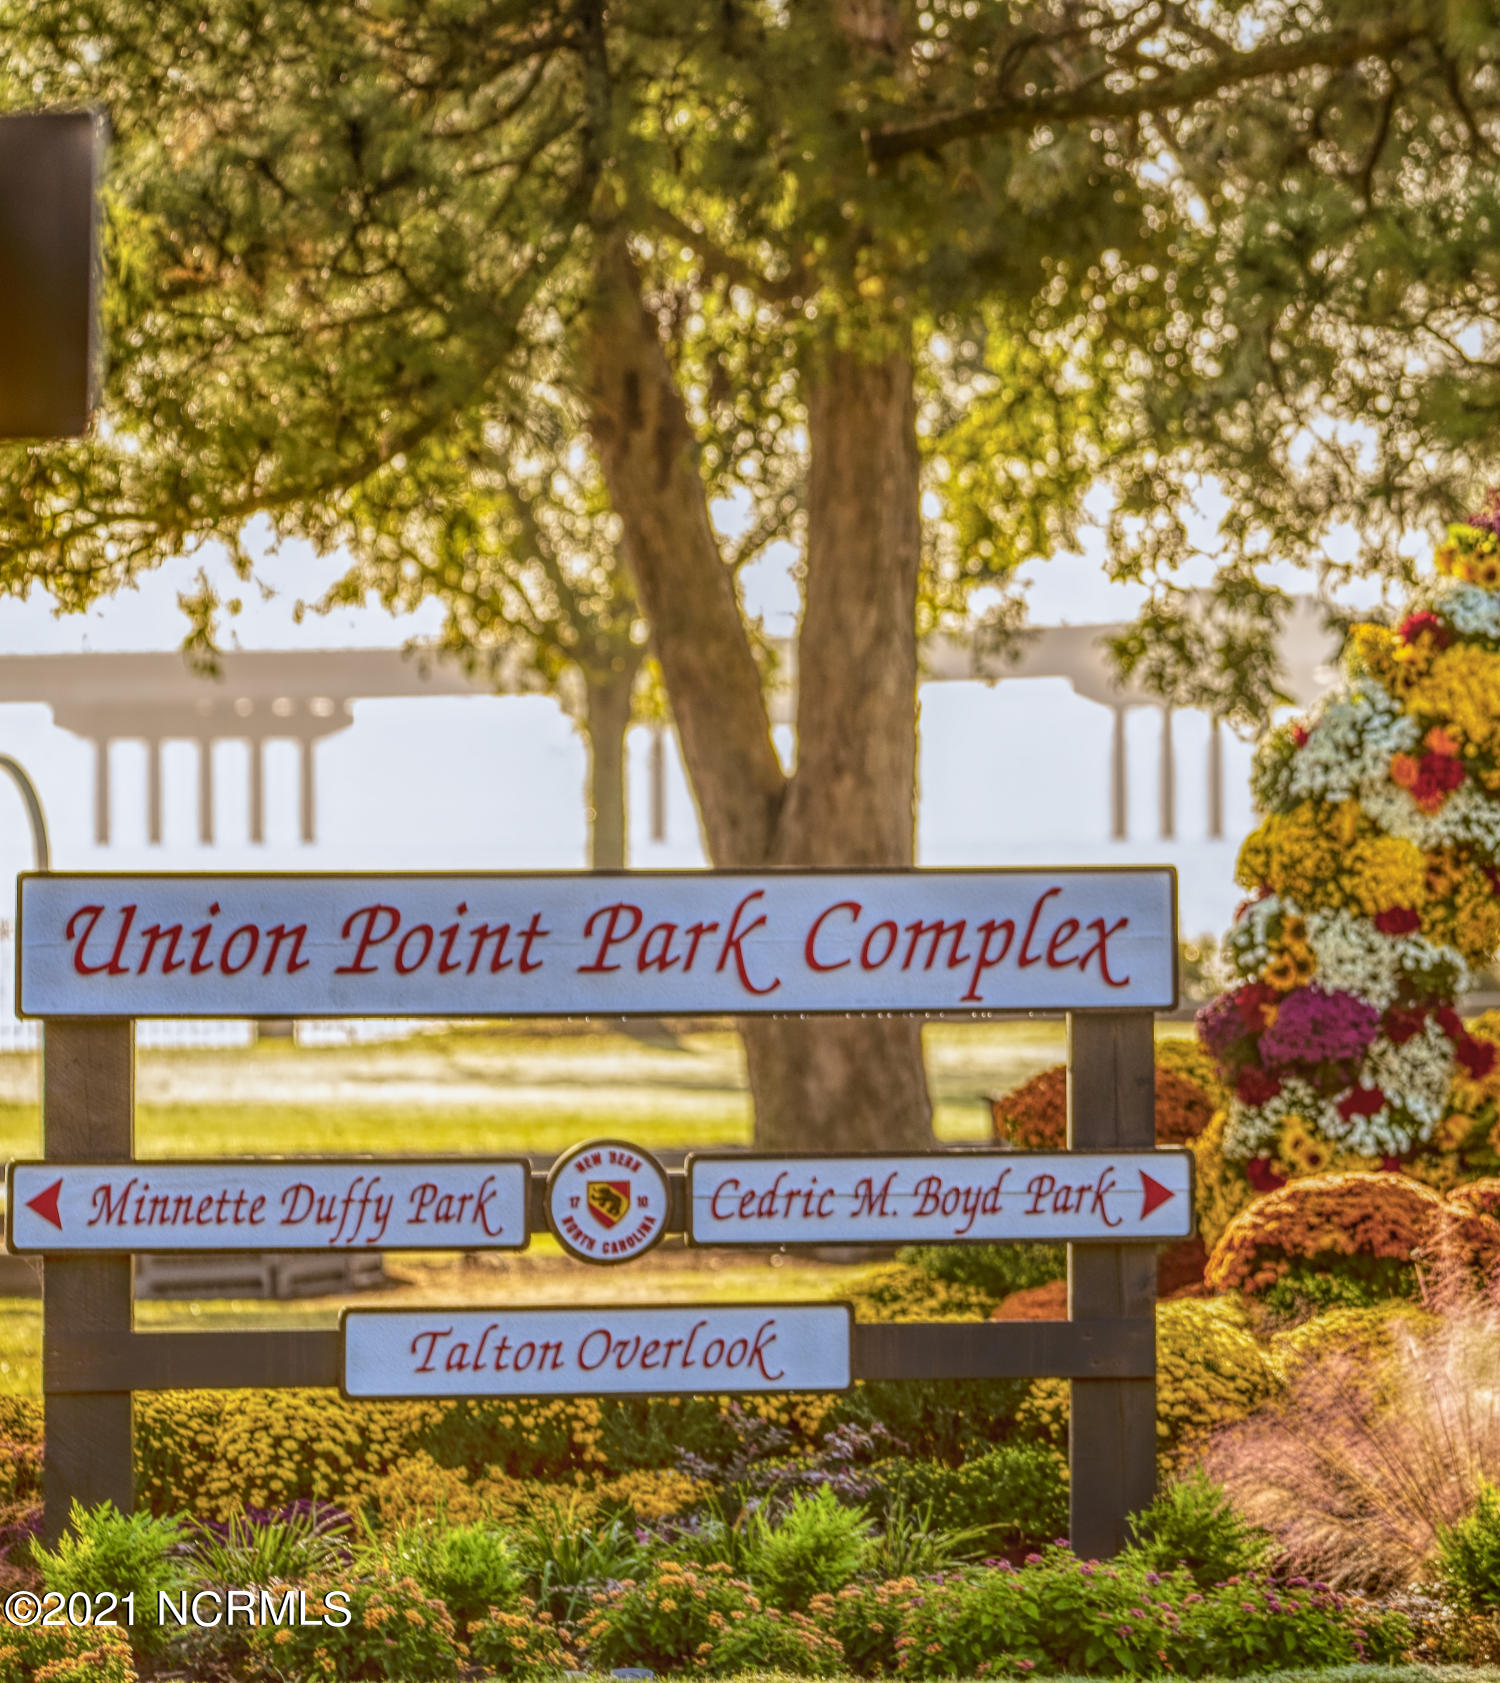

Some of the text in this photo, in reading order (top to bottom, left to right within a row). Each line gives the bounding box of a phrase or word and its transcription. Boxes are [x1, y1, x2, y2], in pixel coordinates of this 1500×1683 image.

[65, 886, 1131, 1003] Union Point Park Complex
[575, 1152, 602, 1173] NEW
[87, 1175, 504, 1245] Minnette Duffy Park
[569, 1195, 582, 1209] 17
[637, 1195, 649, 1209] 10
[711, 1166, 1124, 1234] Cedric M. Boyd Park
[562, 1215, 656, 1254] NORTH CAROLINA
[410, 1319, 785, 1381] Talton Overlook
